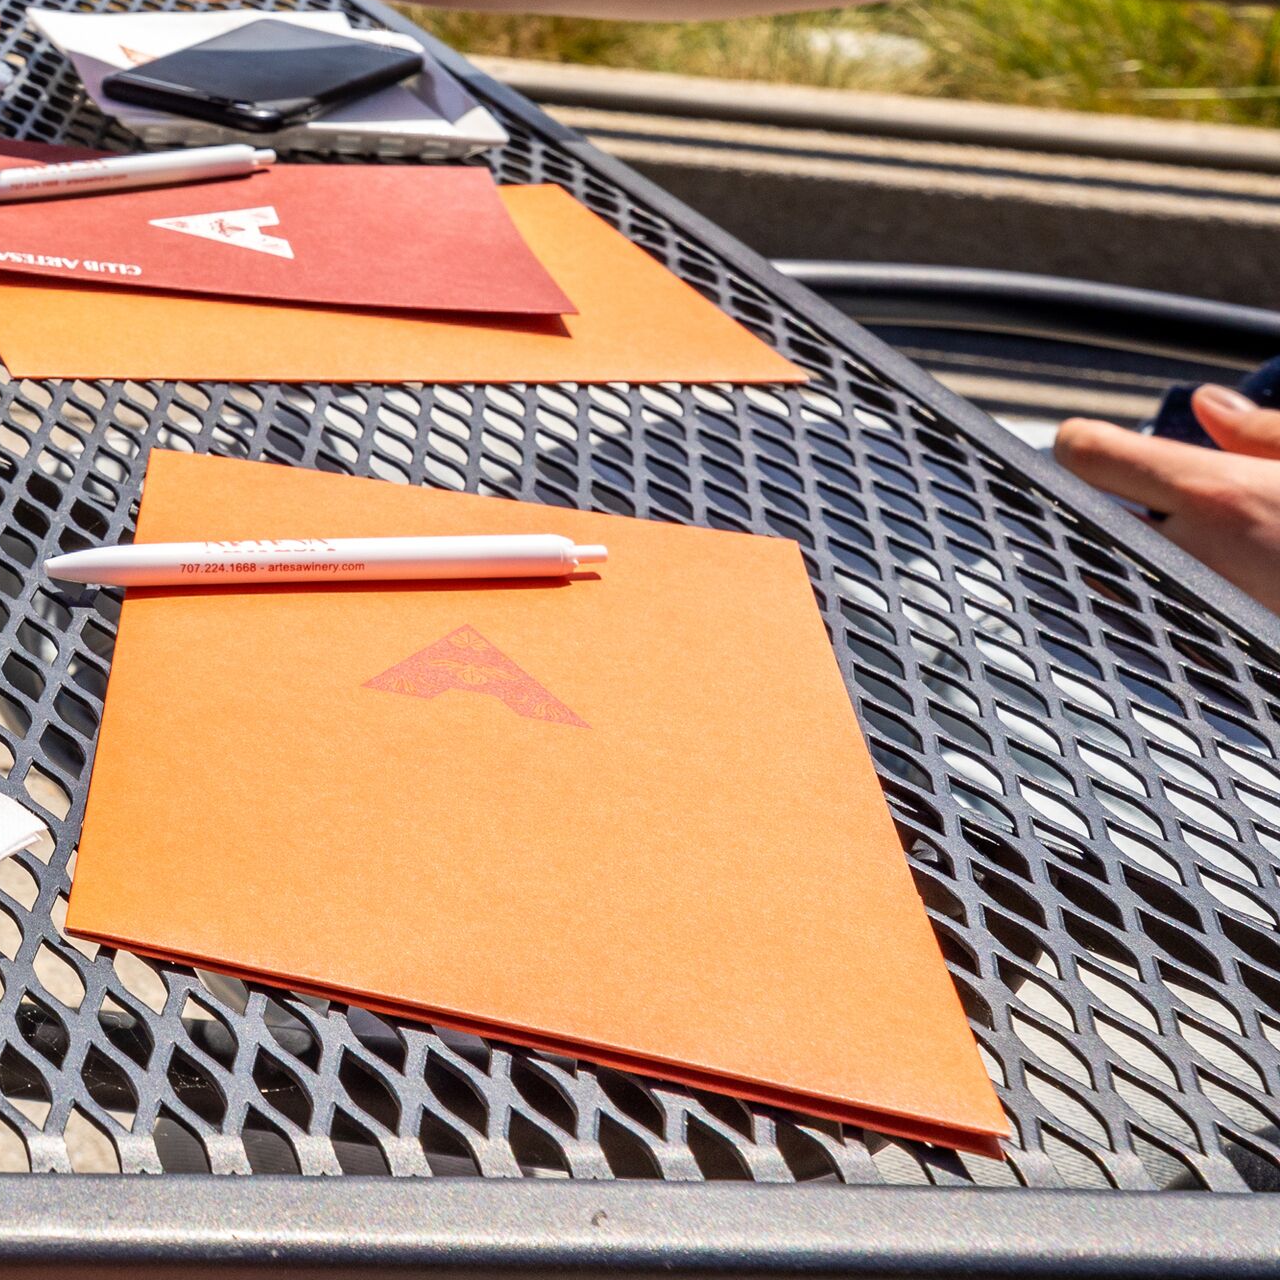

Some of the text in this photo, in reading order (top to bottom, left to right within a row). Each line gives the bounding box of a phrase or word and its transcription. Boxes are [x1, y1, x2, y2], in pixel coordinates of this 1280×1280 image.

[82, 259, 143, 277] CLUB
[179, 562, 257, 574] 707.224.1668
[267, 561, 365, 574] artesawinery.com
